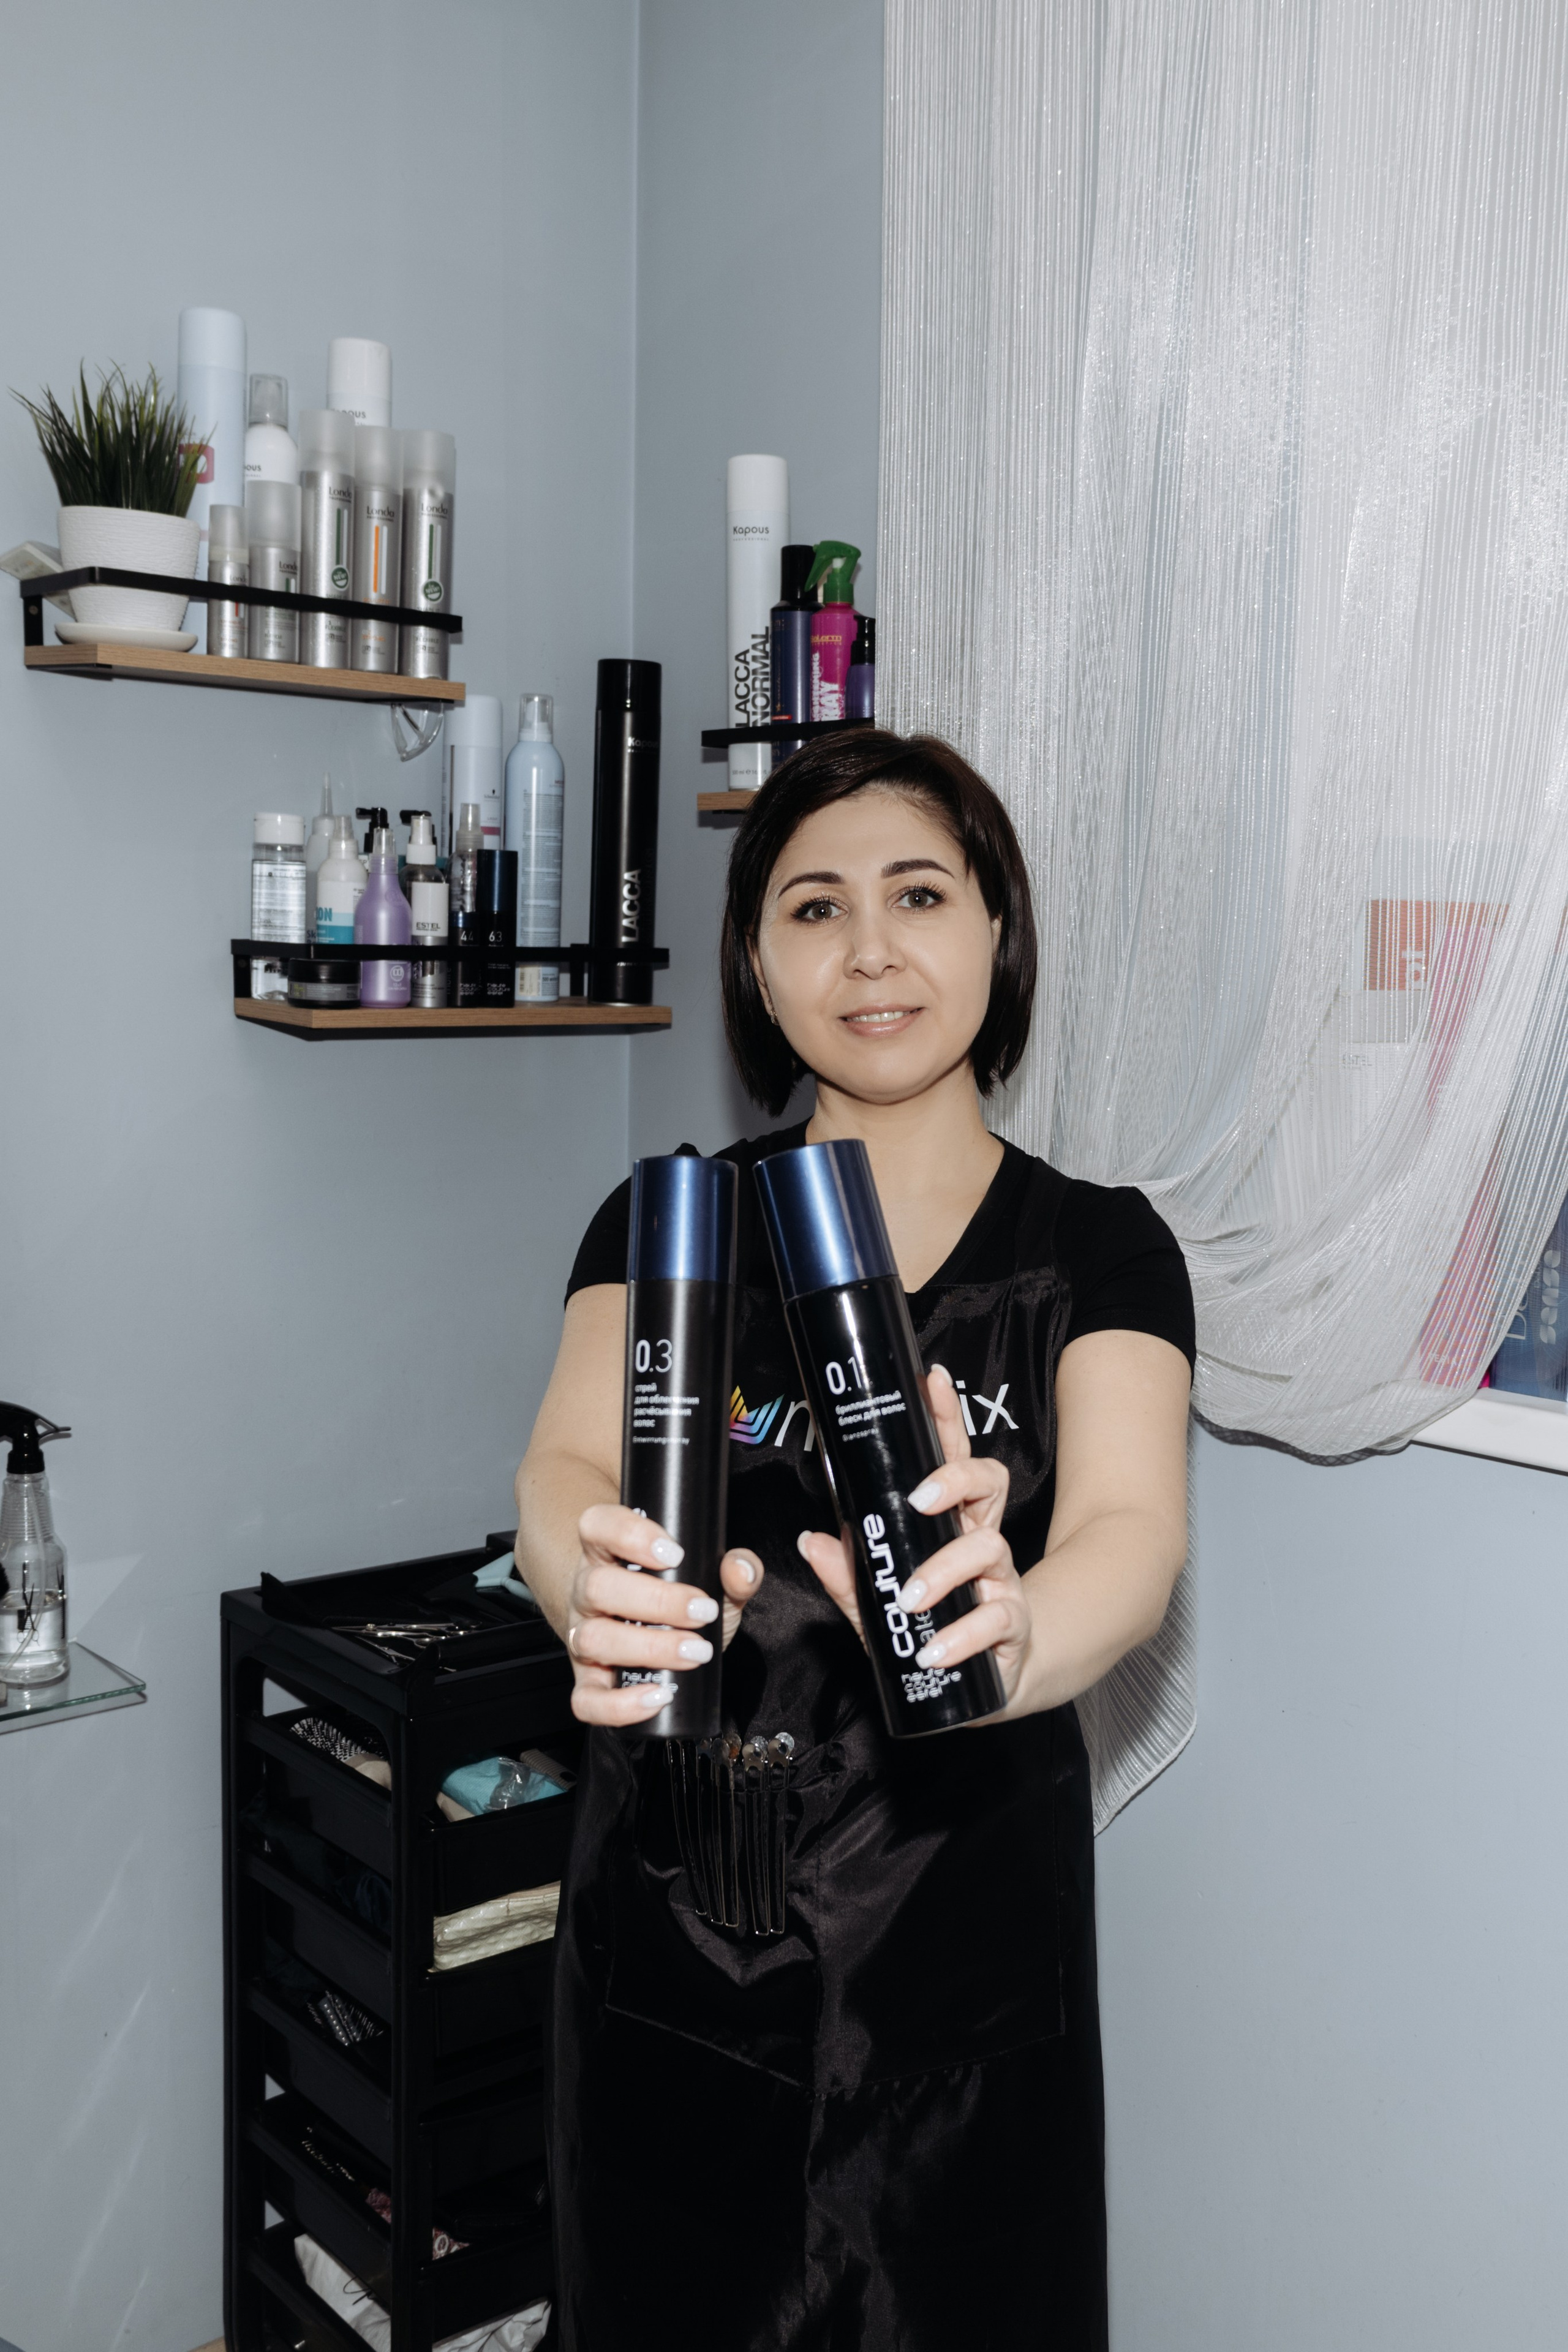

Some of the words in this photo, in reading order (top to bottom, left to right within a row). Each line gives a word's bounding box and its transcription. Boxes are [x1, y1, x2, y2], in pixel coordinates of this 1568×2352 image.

[367, 506, 394, 518] Londa
[421, 503, 448, 514] Londa
[733, 526, 769, 537] Kapous
[734, 649, 750, 728] LACCA
[751, 626, 771, 727] NORMAL
[621, 869, 641, 942] LACCA
[635, 1339, 673, 1373] 0.3
[825, 1356, 862, 1395] 0.1
[633, 1406, 692, 1417] расчёсывния
[634, 1396, 649, 1405] для
[649, 1394, 699, 1405] облегения
[835, 1390, 902, 1415] бриллиантовый
[838, 1413, 862, 1427] блеск
[864, 1408, 881, 1421] для
[881, 1403, 907, 1415] волос
[863, 1513, 915, 1658] couture
[622, 1670, 663, 1684] haute
